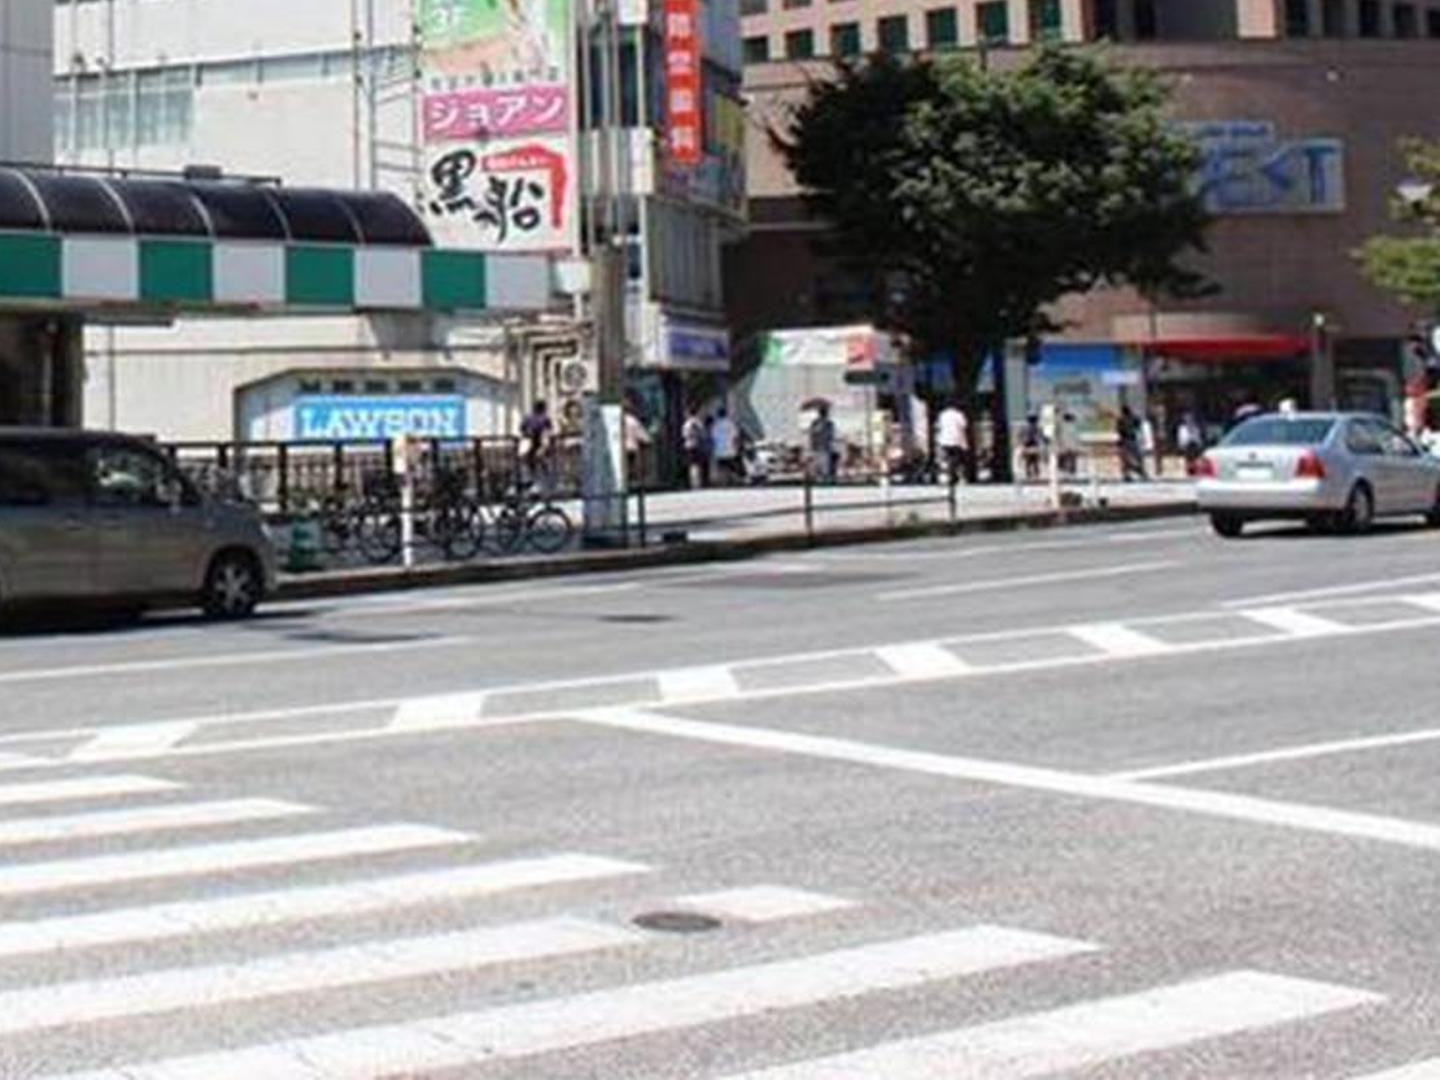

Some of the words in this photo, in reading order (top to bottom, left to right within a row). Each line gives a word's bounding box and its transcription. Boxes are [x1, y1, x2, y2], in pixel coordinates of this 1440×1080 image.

[432, 90, 564, 131] ジョアン
[300, 406, 457, 438] LAWSON
